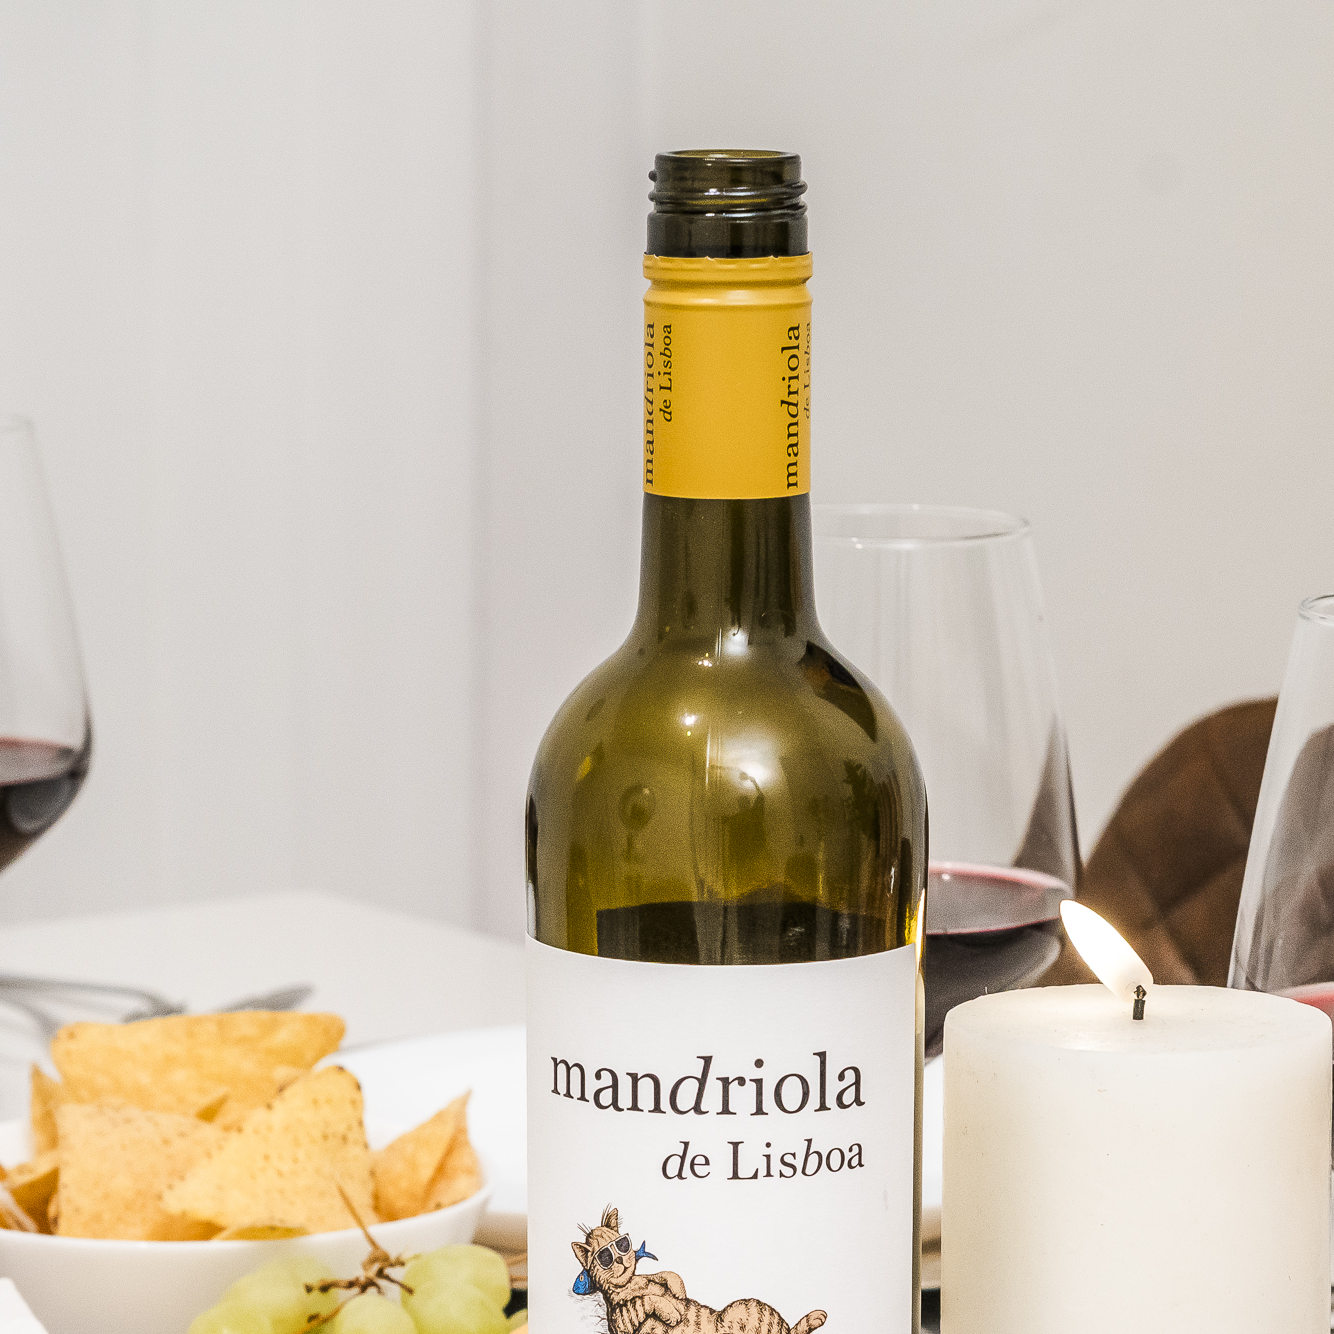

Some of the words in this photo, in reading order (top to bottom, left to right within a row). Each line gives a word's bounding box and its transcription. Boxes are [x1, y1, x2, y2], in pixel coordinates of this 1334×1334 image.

[659, 324, 673, 393] Lisboa
[645, 322, 655, 487] mandriola
[659, 399, 673, 422] de
[780, 323, 800, 490] mandriola
[551, 1051, 865, 1116] mandriola
[662, 1141, 710, 1180] de
[727, 1138, 865, 1180] Lisboa
